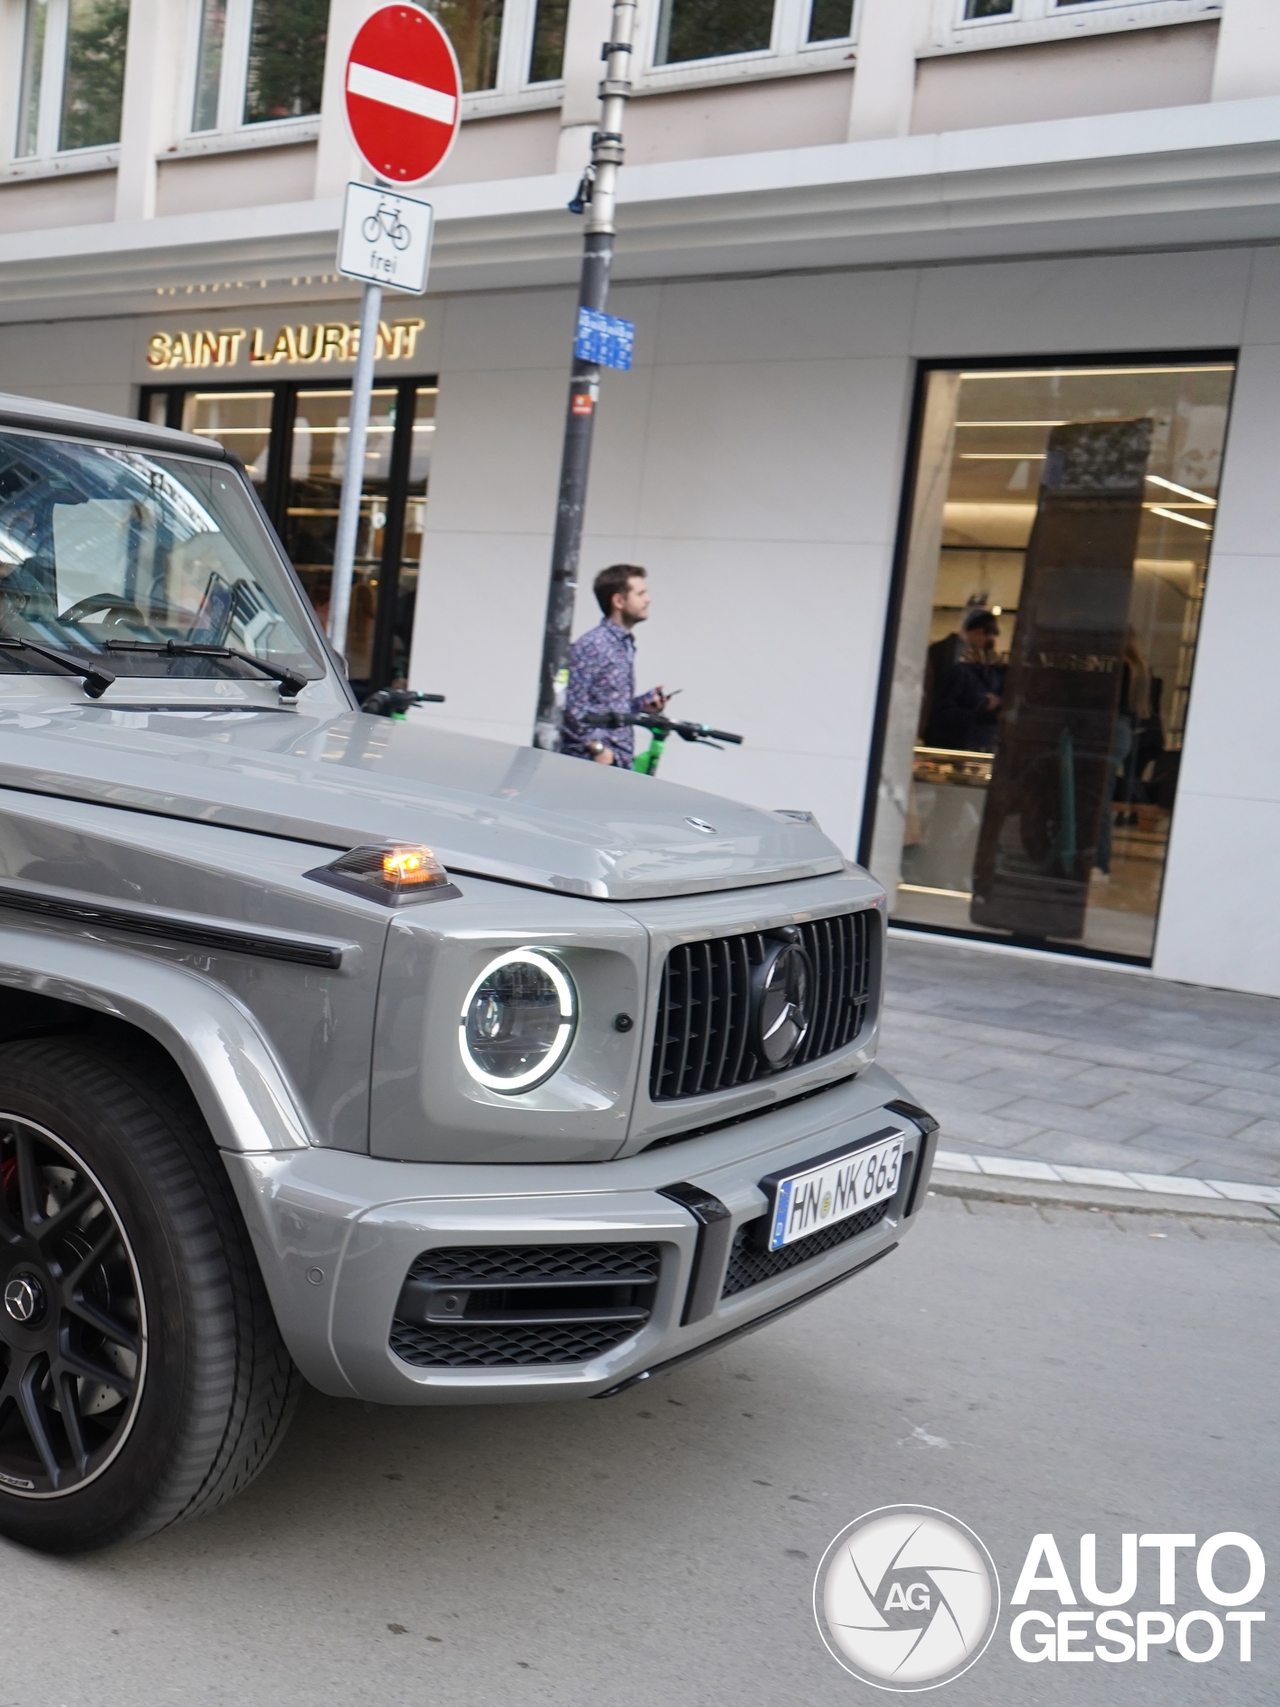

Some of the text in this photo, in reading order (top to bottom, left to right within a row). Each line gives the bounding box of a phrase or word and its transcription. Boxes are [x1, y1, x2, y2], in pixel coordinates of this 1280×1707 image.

[370, 250, 398, 275] frei
[147, 328, 245, 370] SAINT
[789, 1143, 901, 1235] HN NK 863
